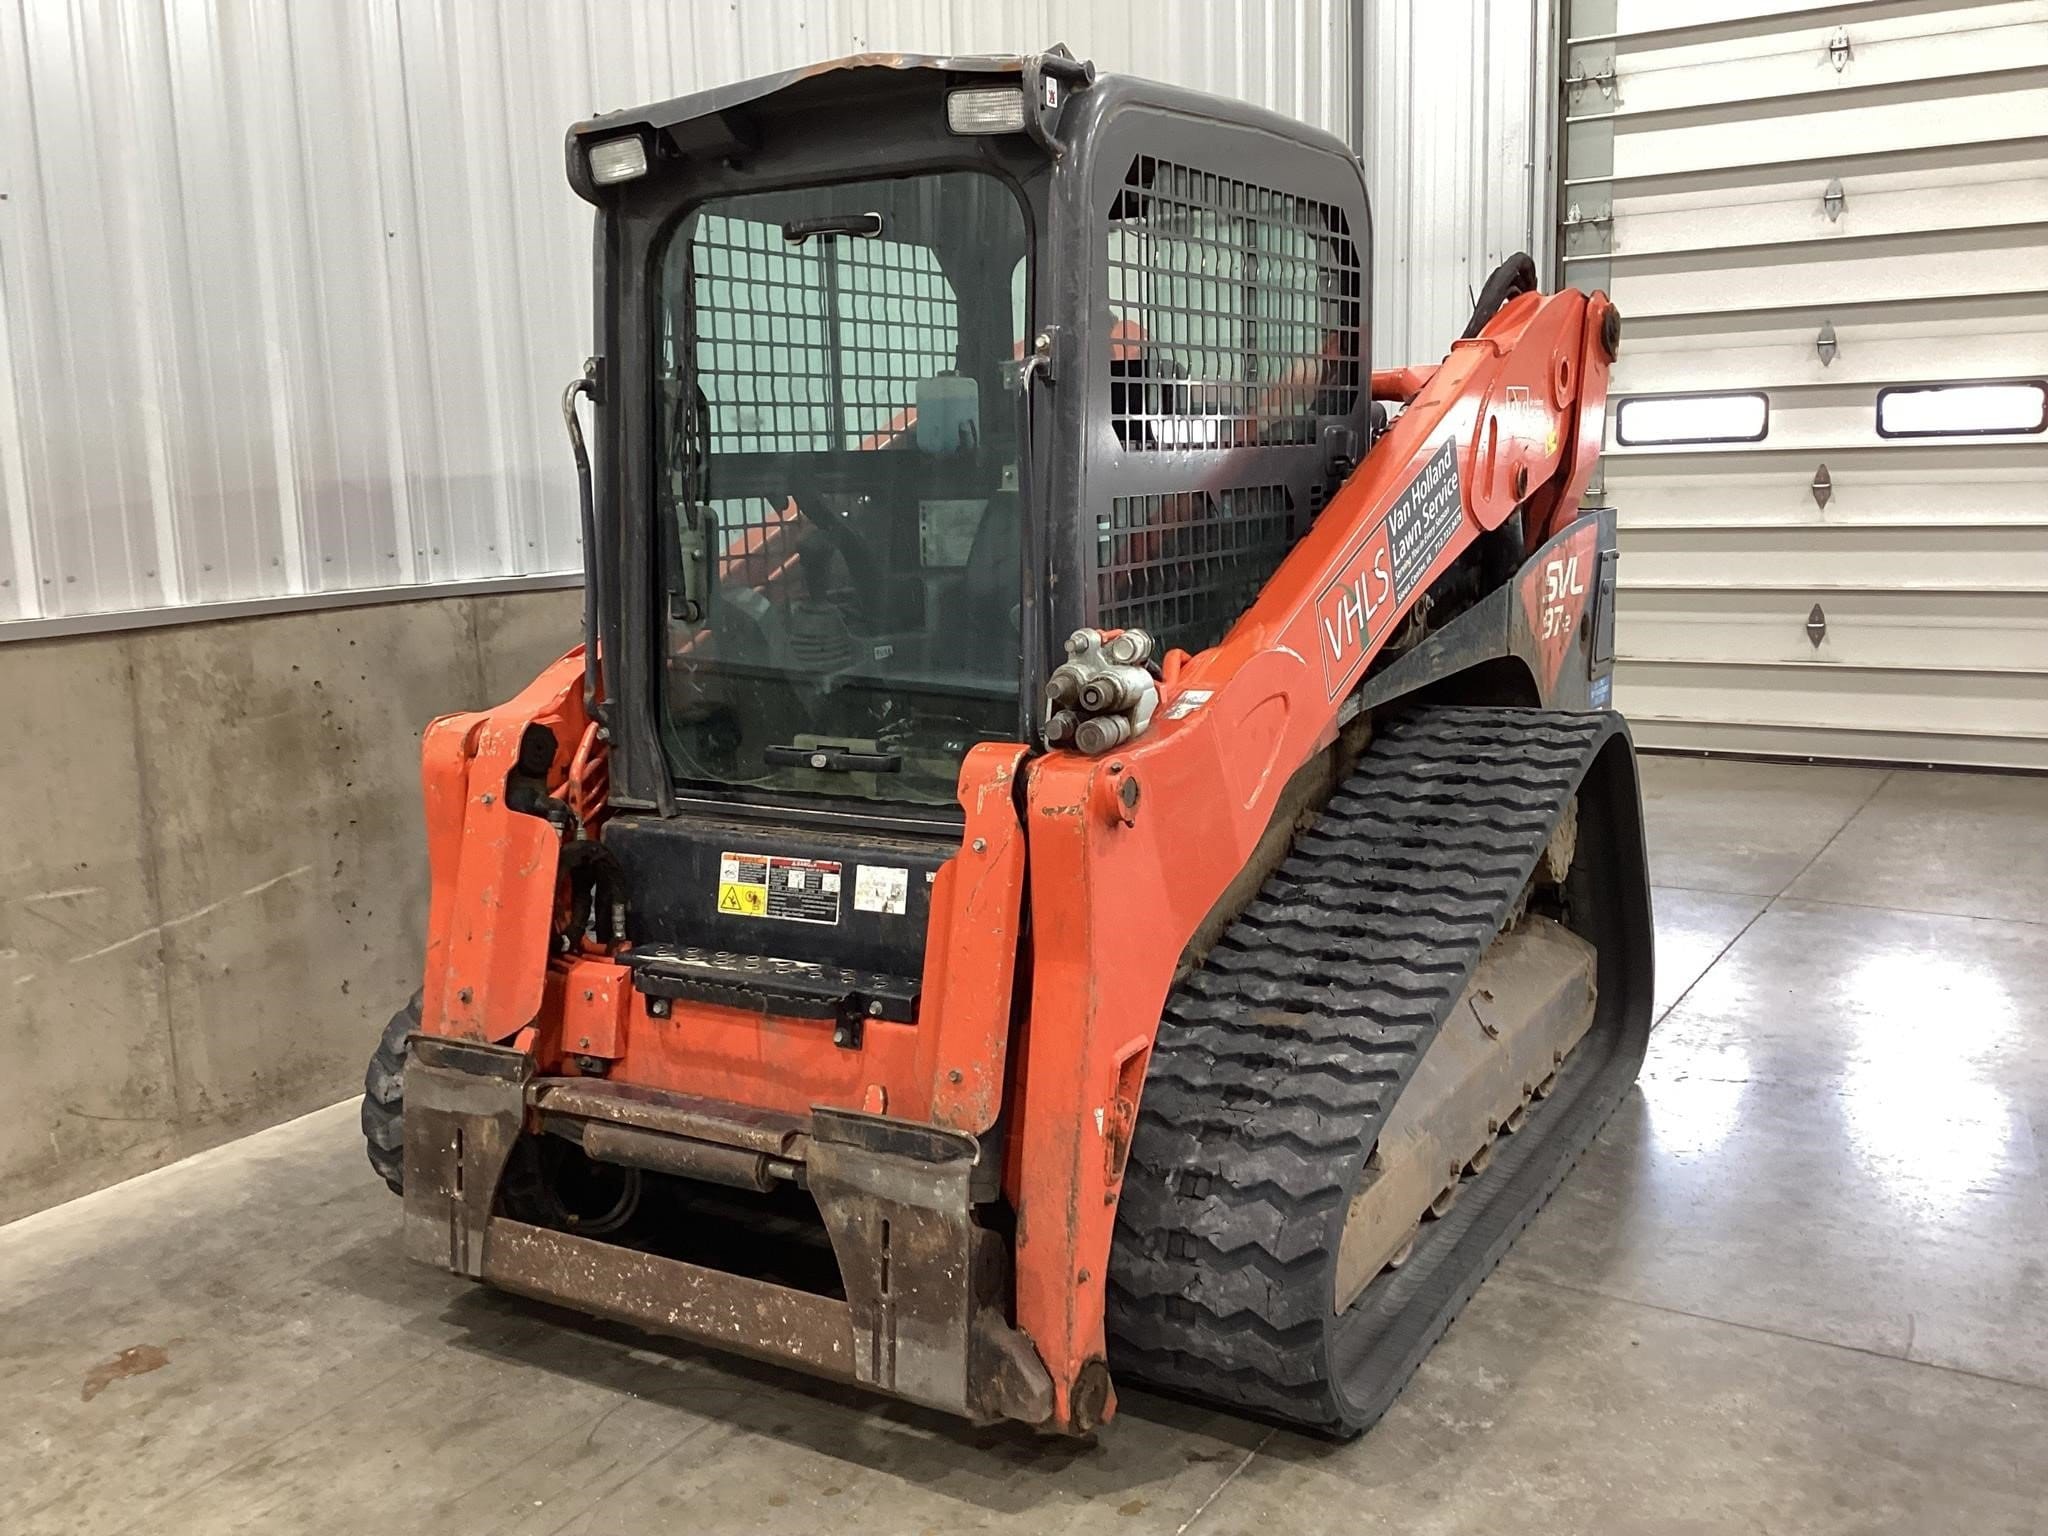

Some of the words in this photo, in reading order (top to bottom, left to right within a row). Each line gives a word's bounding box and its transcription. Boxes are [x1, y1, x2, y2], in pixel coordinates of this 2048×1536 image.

[1388, 500, 1411, 536] Van
[1411, 442, 1451, 510] Holland
[1392, 520, 1421, 567] Lawn
[1422, 472, 1458, 528] Service
[1325, 547, 1389, 661] VHLS
[1542, 556, 1584, 603] SVL
